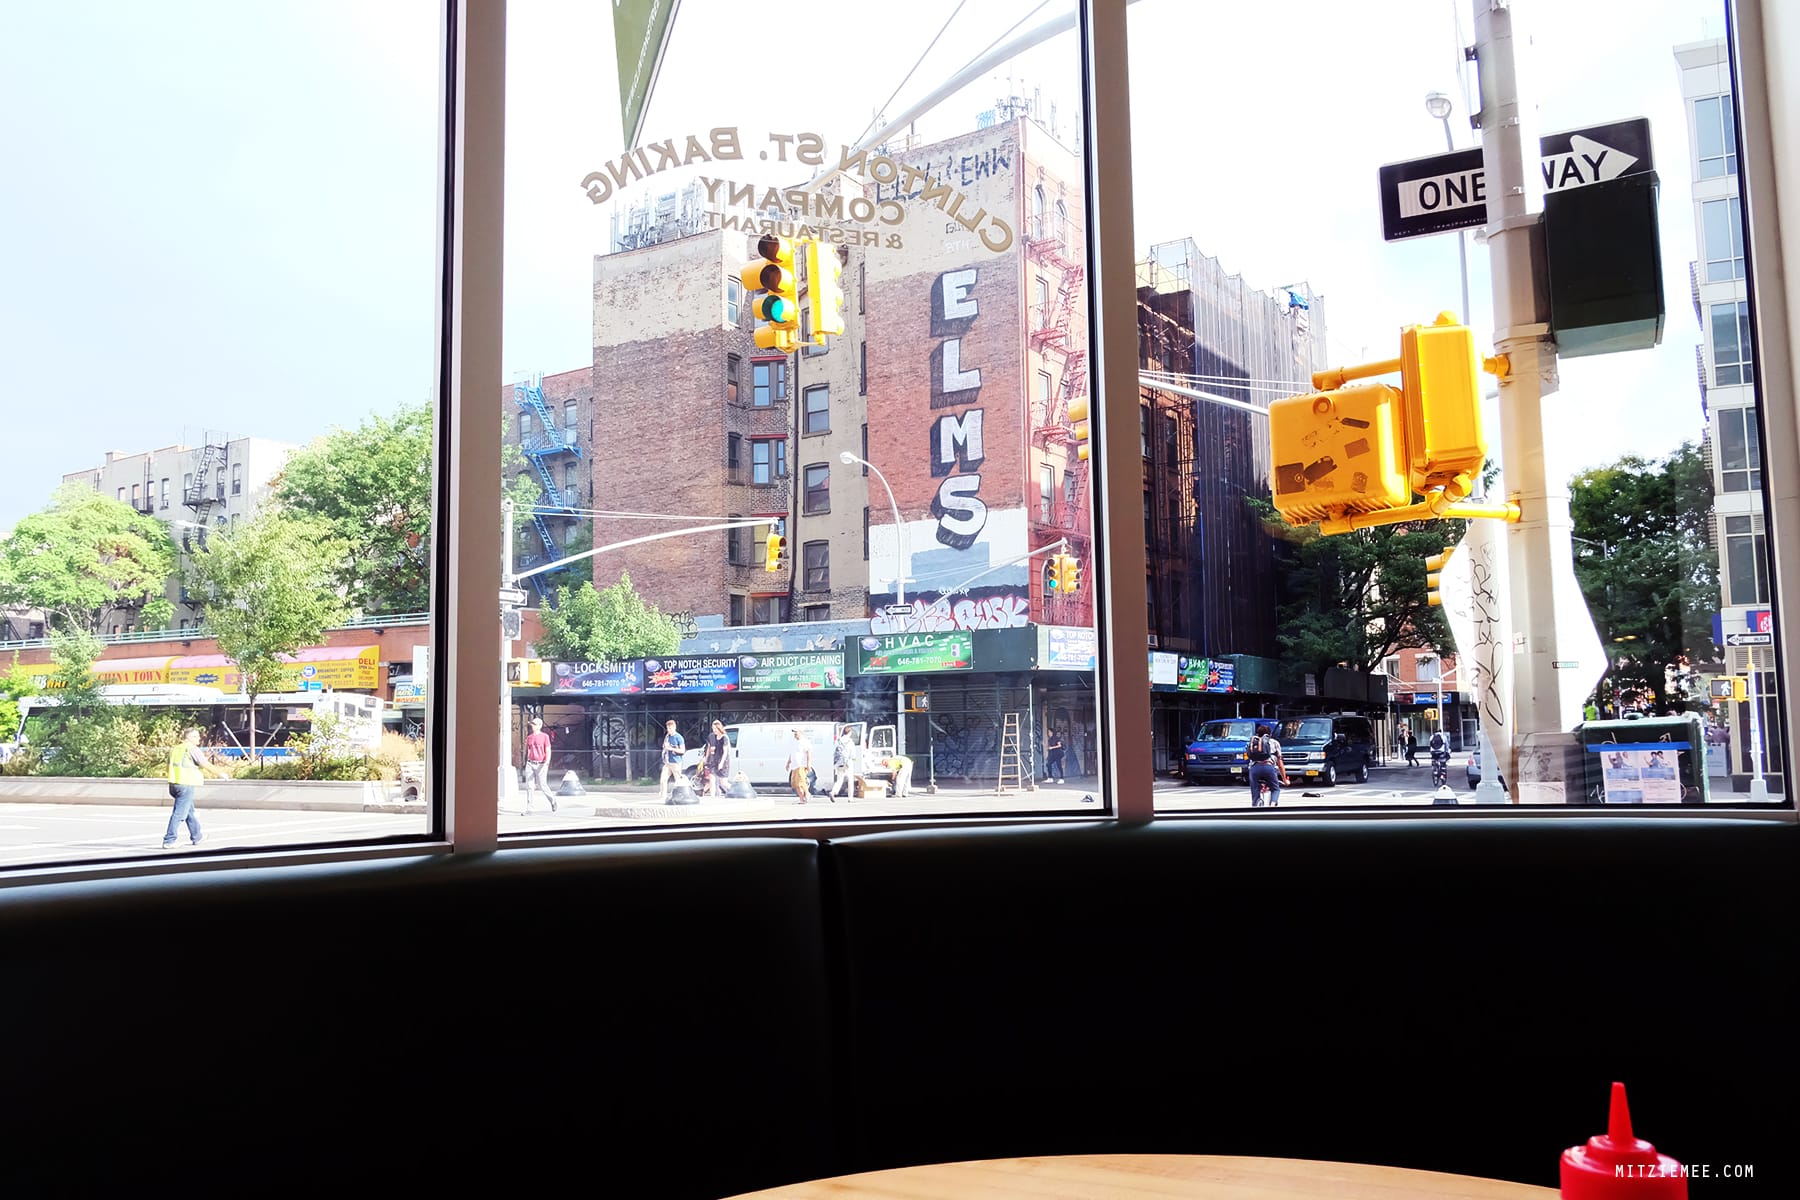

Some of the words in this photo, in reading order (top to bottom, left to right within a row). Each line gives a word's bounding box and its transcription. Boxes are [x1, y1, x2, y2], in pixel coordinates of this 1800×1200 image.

[1419, 172, 1486, 210] ONE
[931, 267, 988, 549] ELMS
[575, 661, 635, 673] LOCKSMITH
[664, 661, 677, 669] TOP
[679, 660, 701, 669] NOTCH
[703, 659, 737, 668] SECURITY
[761, 657, 775, 667] AIR
[777, 656, 798, 666] DUCT
[800, 655, 841, 665] CLEANING
[97, 672, 129, 683] CHINA
[134, 671, 162, 682] TOWN
